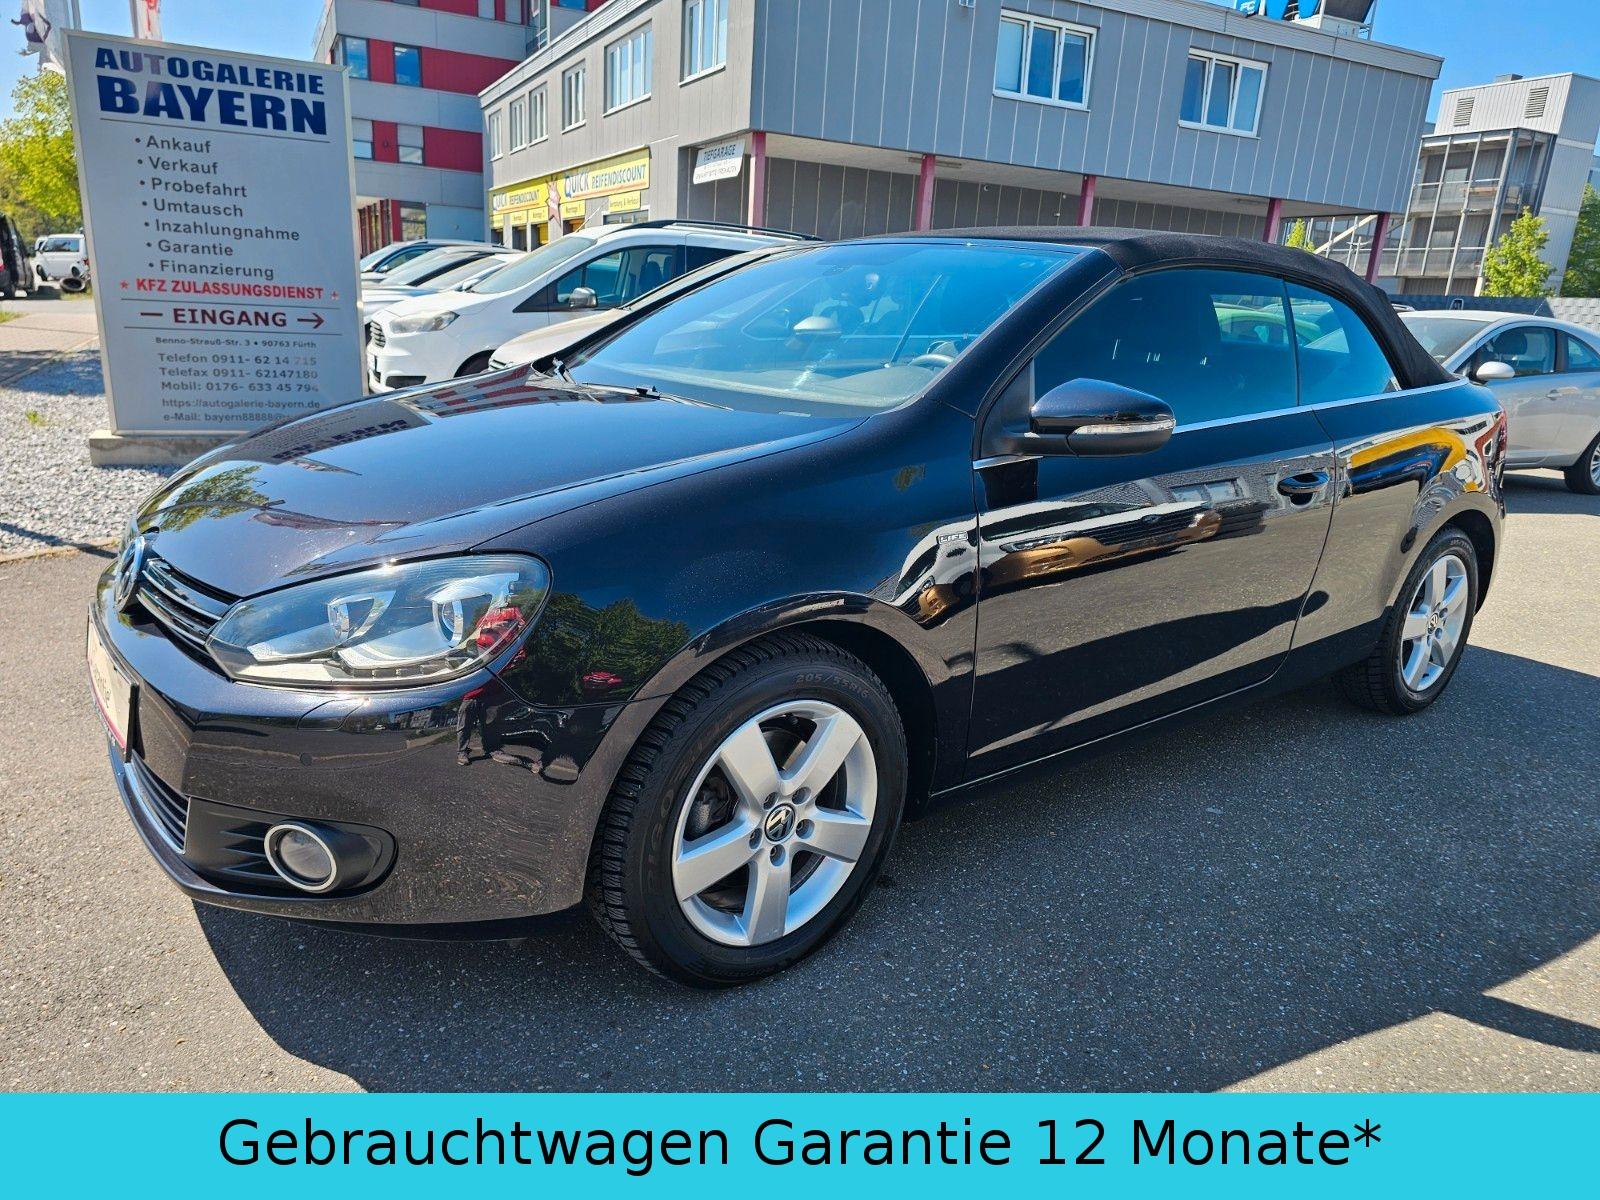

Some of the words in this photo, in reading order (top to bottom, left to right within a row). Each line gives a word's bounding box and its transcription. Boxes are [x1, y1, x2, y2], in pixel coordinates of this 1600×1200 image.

[95, 47, 324, 95] AUTOGALERIE
[97, 75, 327, 135] BAYERN
[146, 135, 211, 154] Ankauf
[149, 156, 218, 175] Verkauf
[151, 177, 247, 198] Probefahrt
[565, 171, 589, 198] QUICK
[592, 164, 646, 189] REIFENDISCOUNT
[154, 199, 243, 217] Umtausch
[155, 219, 300, 241] Inzahlungnahme
[158, 239, 234, 256] Garantie
[160, 260, 274, 280] Finanzierung
[136, 278, 167, 292] KFZ
[171, 280, 324, 300] ZULASSUNGSDIENST
[173, 308, 287, 327] EINGANG
[244, 339, 251, 347] 3
[261, 340, 290, 348] 90763
[158, 353, 207, 363] Telefon
[212, 354, 250, 364] 0911-
[254, 356, 271, 364] 62
[275, 356, 290, 365] 14
[160, 367, 208, 377] Telefax
[255, 369, 319, 379] 62147180
[161, 381, 201, 391] Mobil:
[249, 382, 272, 392] 633
[276, 383, 291, 392] 45
[163, 413, 200, 422] e-Mail:
